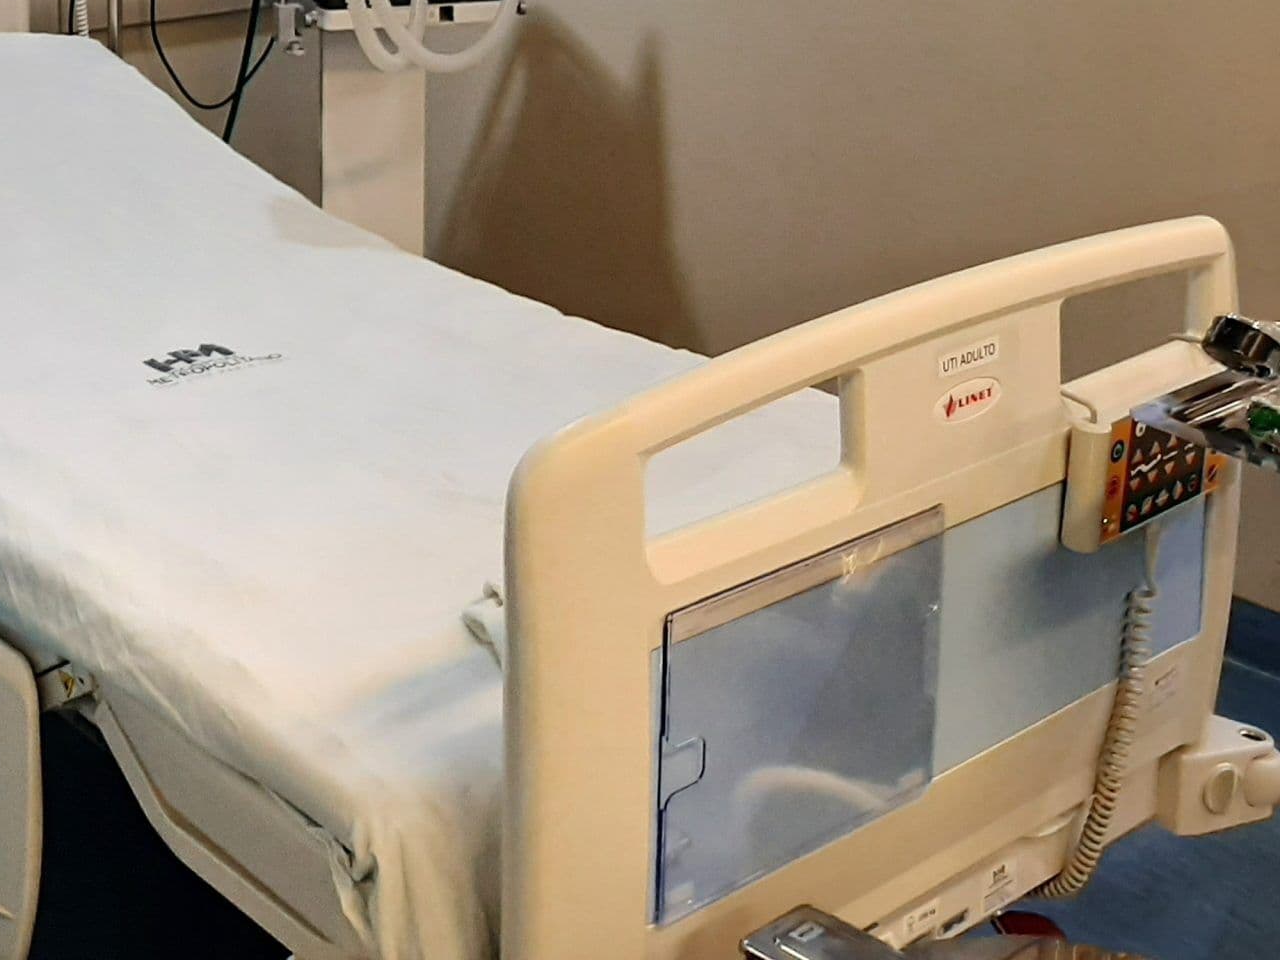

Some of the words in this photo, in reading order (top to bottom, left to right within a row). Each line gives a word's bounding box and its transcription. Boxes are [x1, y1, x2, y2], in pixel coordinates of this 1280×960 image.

[942, 355, 958, 373] UTI
[959, 342, 996, 367] ADULTO
[957, 387, 993, 408] LINET
